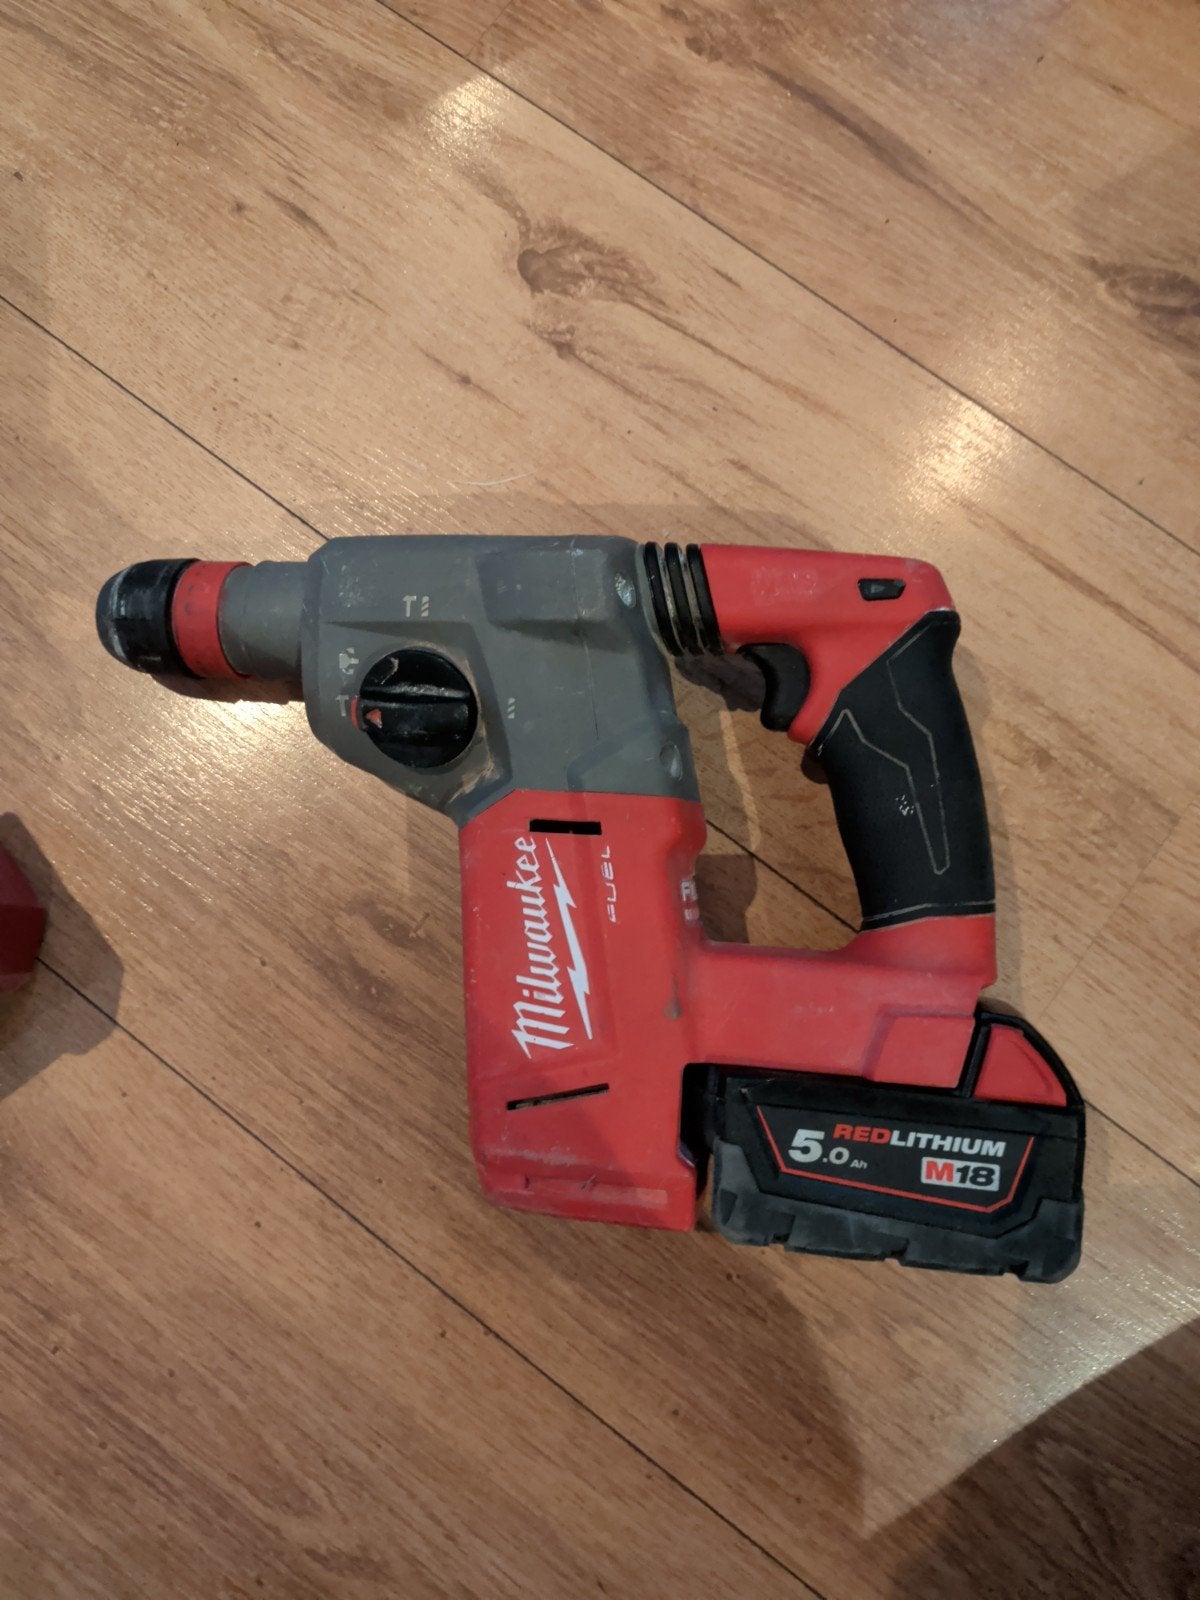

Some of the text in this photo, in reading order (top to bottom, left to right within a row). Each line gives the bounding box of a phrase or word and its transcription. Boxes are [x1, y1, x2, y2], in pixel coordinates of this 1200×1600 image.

[601, 845, 617, 923] FUEL
[506, 836, 575, 1060] Milwaukee
[788, 1128, 850, 1165] 5.0
[833, 1123, 1006, 1158] REDLITHIUM
[924, 1160, 996, 1187] M18
